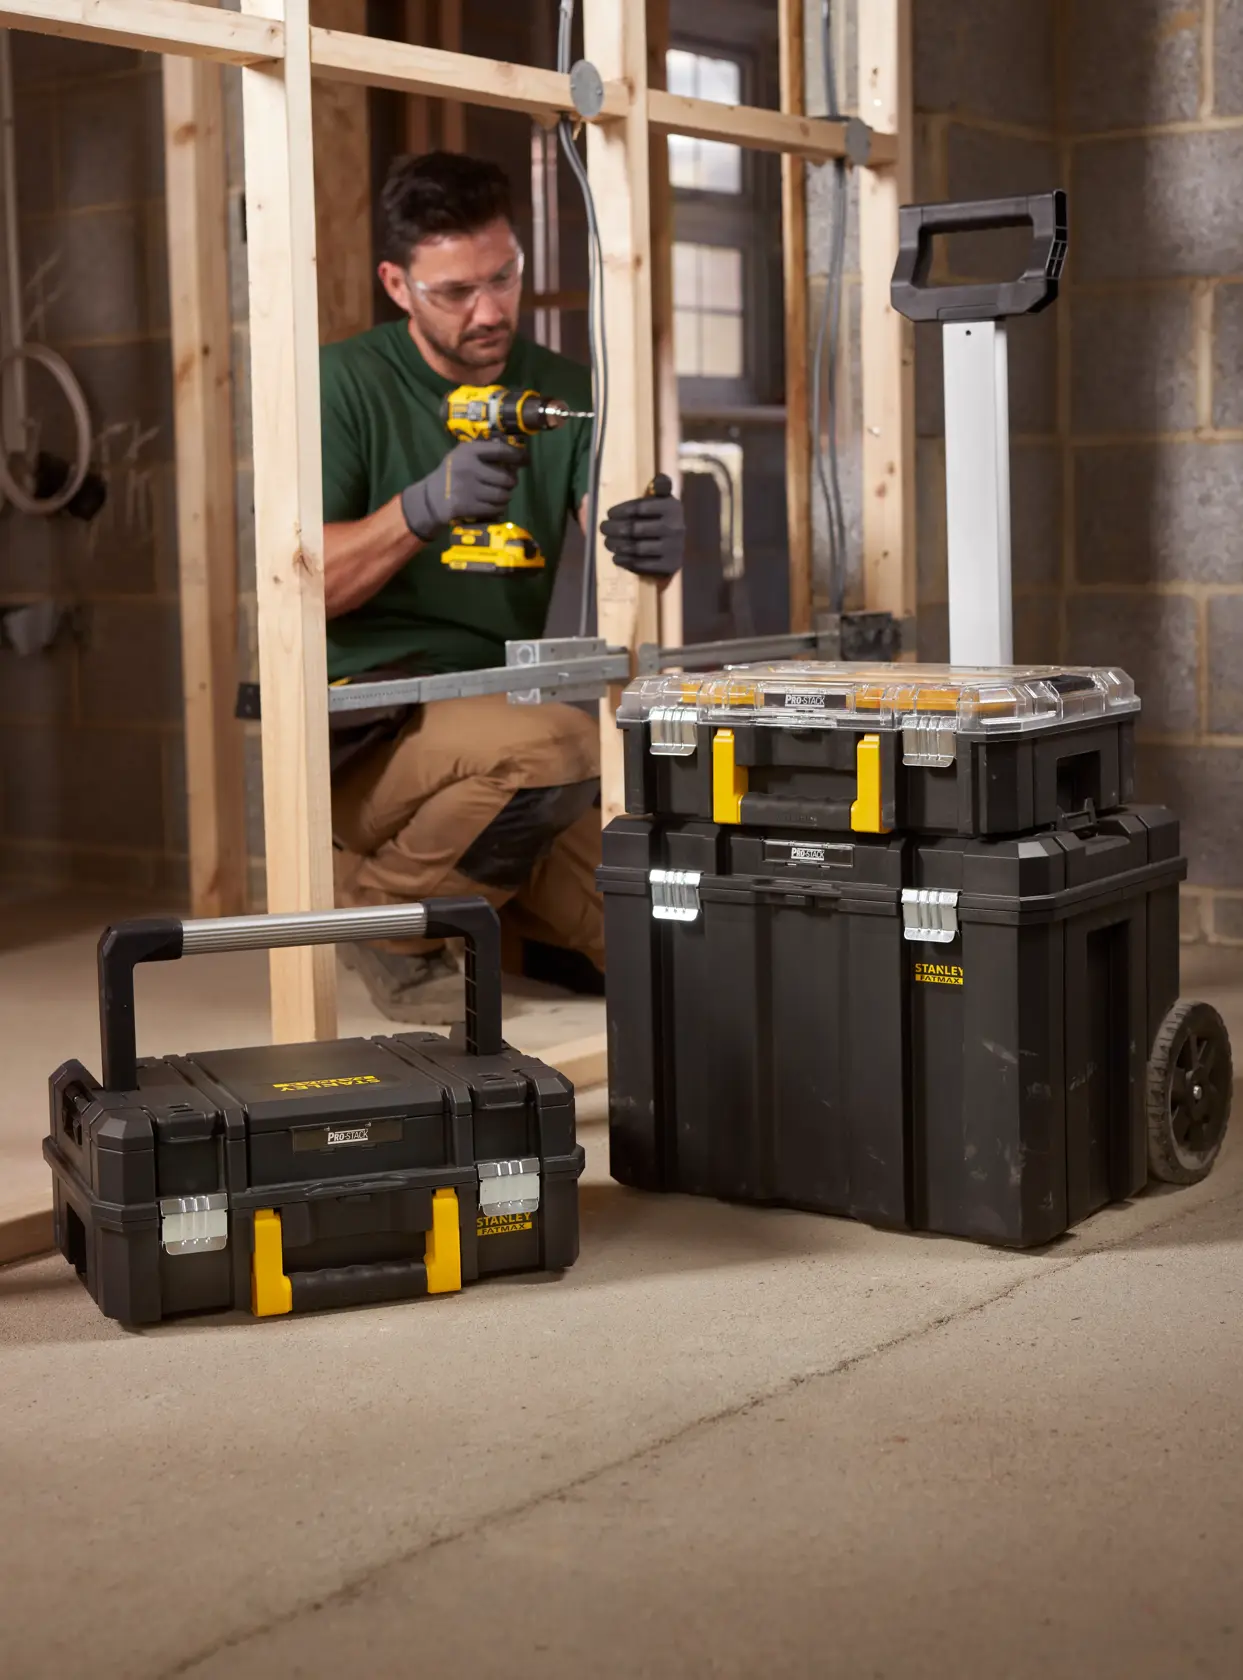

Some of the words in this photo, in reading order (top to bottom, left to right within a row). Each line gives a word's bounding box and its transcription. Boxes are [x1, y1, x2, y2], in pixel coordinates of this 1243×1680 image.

[785, 694, 825, 706] PRO-STACK
[791, 848, 825, 859] PRO-STACK
[915, 963, 963, 976] STANLEY
[327, 1129, 369, 1143] PRO-STACK
[476, 1212, 531, 1228] STANLEY
[482, 1223, 525, 1235] FATMAX
